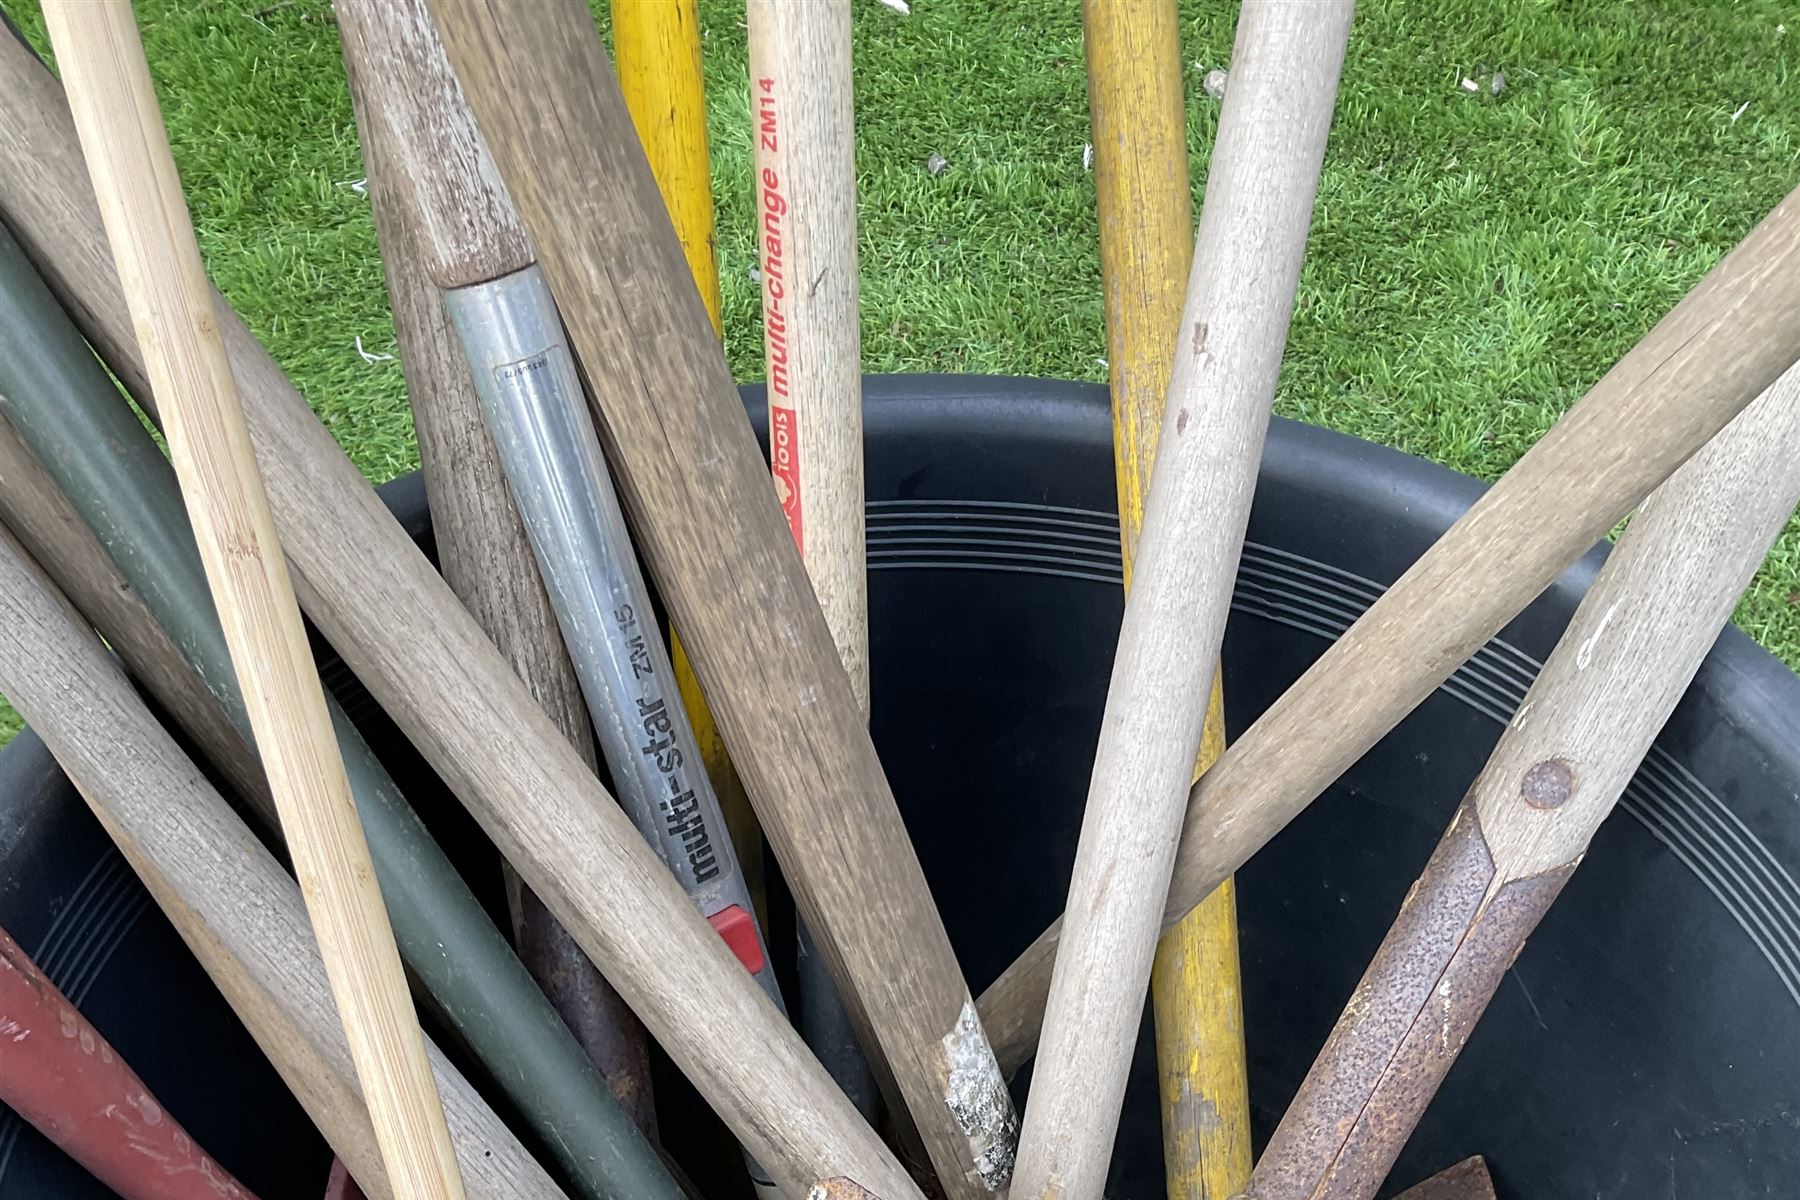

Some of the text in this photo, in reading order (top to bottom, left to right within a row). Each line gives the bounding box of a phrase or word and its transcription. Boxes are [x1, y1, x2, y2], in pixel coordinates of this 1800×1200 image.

[759, 78, 778, 152] ZM14
[762, 167, 788, 397] multi-change
[636, 698, 720, 884] multi-star
